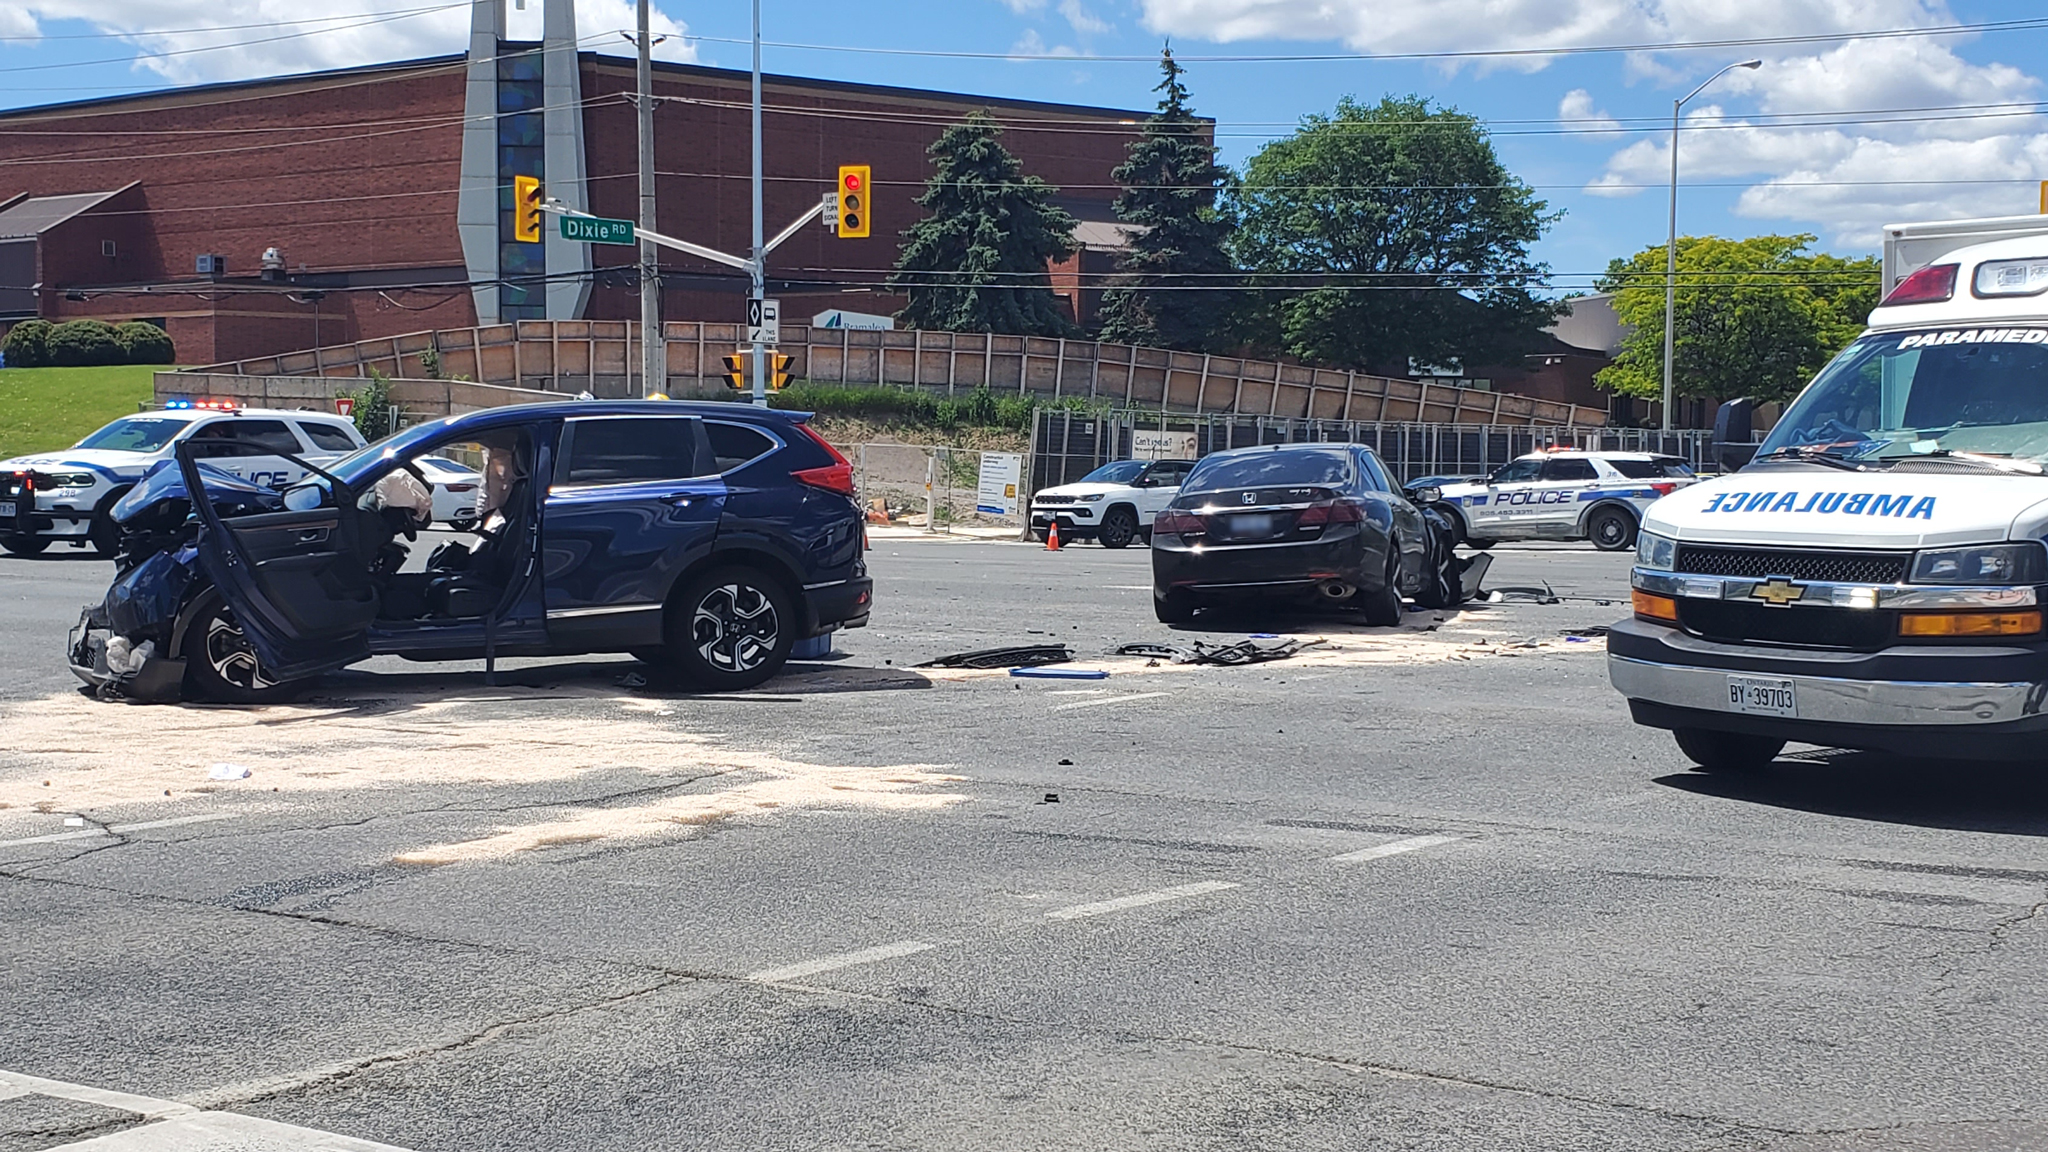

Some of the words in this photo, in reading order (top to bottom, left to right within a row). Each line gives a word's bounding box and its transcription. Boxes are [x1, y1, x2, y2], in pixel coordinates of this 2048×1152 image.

[825, 196, 838, 204] LEFT
[567, 220, 609, 239] Dixie
[612, 224, 627, 235] RD
[1494, 490, 1574, 506] POLICE
[1730, 684, 1745, 704] BY
[1753, 687, 1793, 709] 39703
